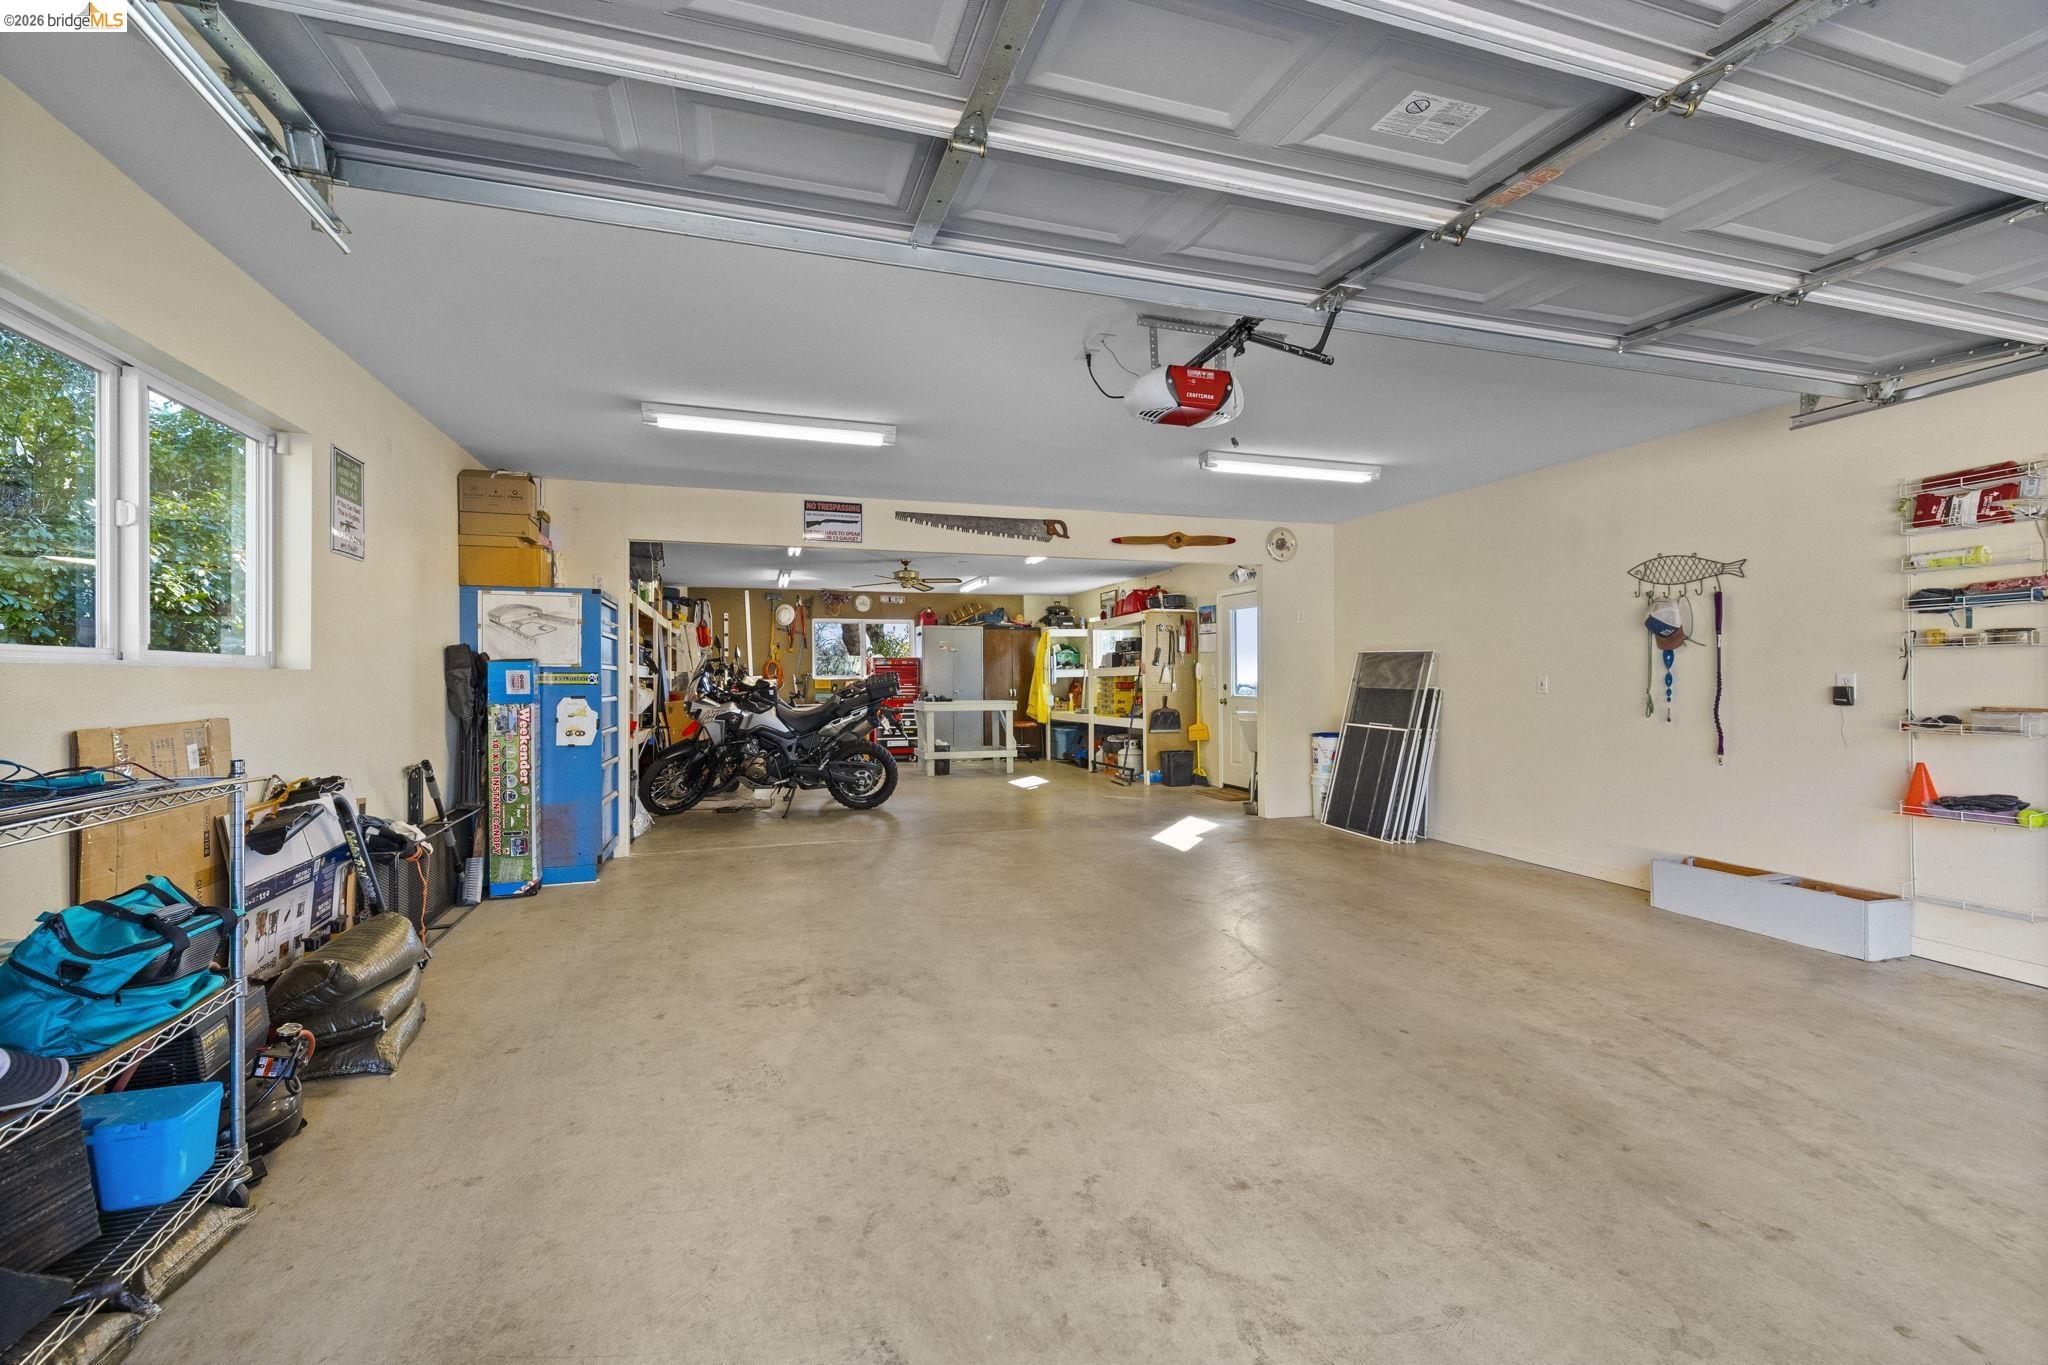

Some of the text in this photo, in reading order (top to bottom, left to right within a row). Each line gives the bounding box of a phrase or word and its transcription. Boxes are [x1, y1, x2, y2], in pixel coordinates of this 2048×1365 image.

[1186, 392, 1214, 400] CRAFTSMAN
[817, 503, 860, 512] TRESPASSING
[519, 707, 531, 785] Weekender
[492, 776, 500, 814] INSTANT
[492, 817, 501, 856] CANOPY
